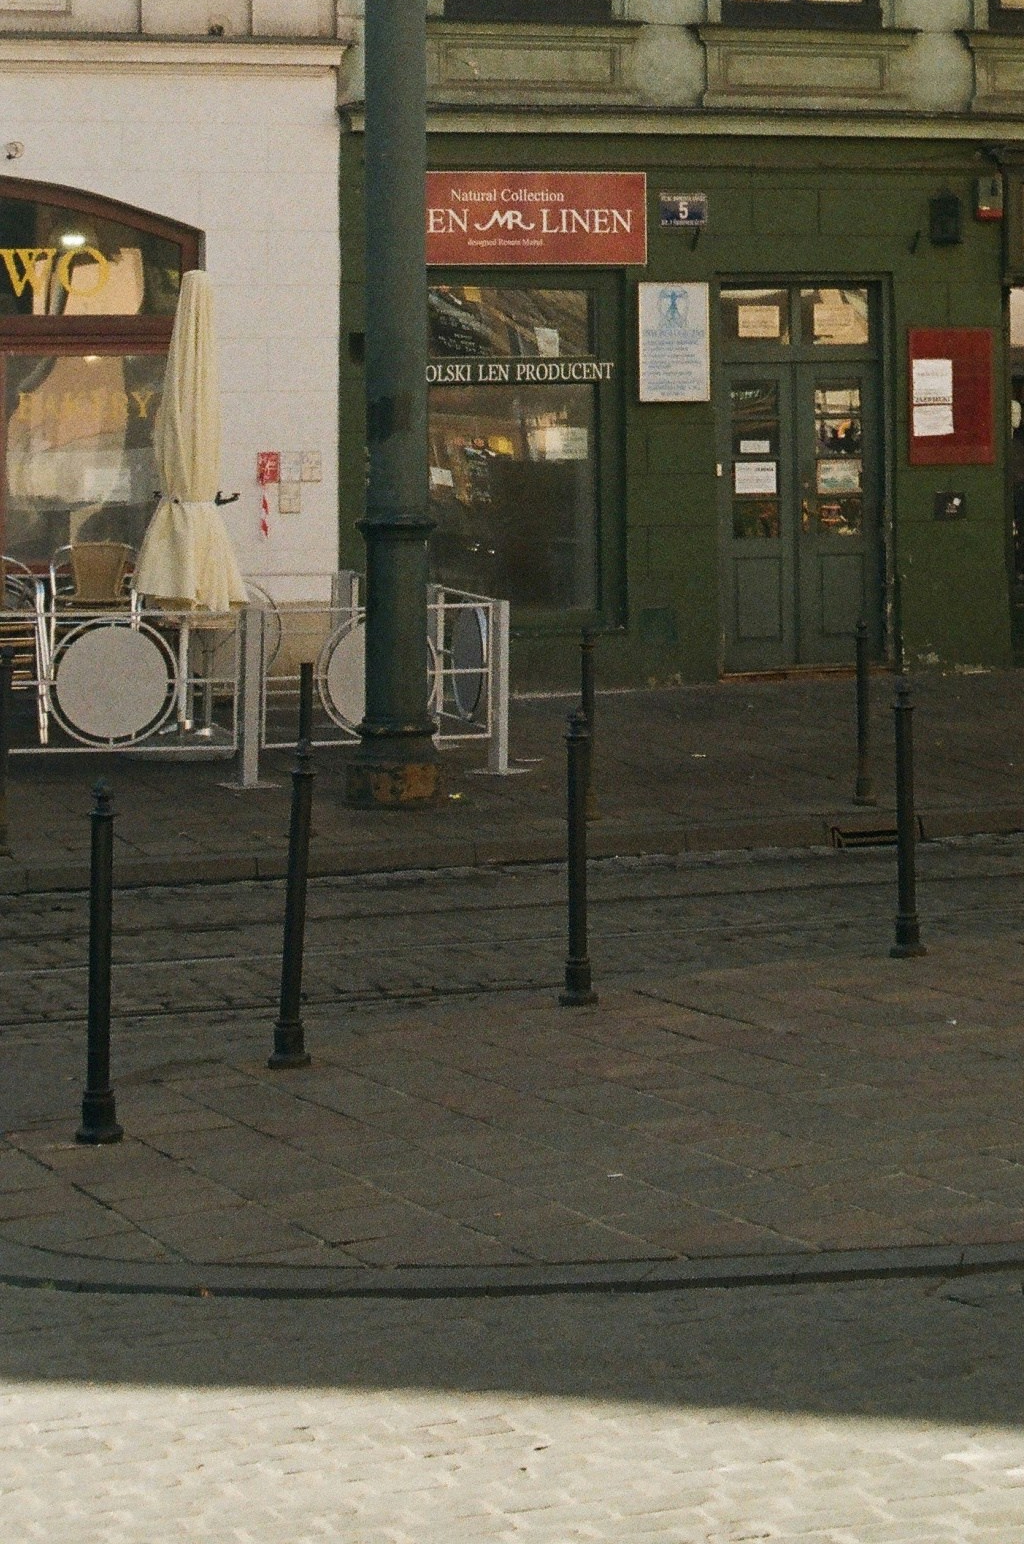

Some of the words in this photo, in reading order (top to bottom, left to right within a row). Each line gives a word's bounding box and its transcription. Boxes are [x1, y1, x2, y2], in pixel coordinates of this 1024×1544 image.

[450, 188, 497, 203] Natural
[500, 188, 565, 203] Collection
[679, 200, 689, 220] 5
[540, 208, 633, 234] LINEN
[478, 363, 511, 382] LEN
[516, 361, 615, 382] PRODUCENT
